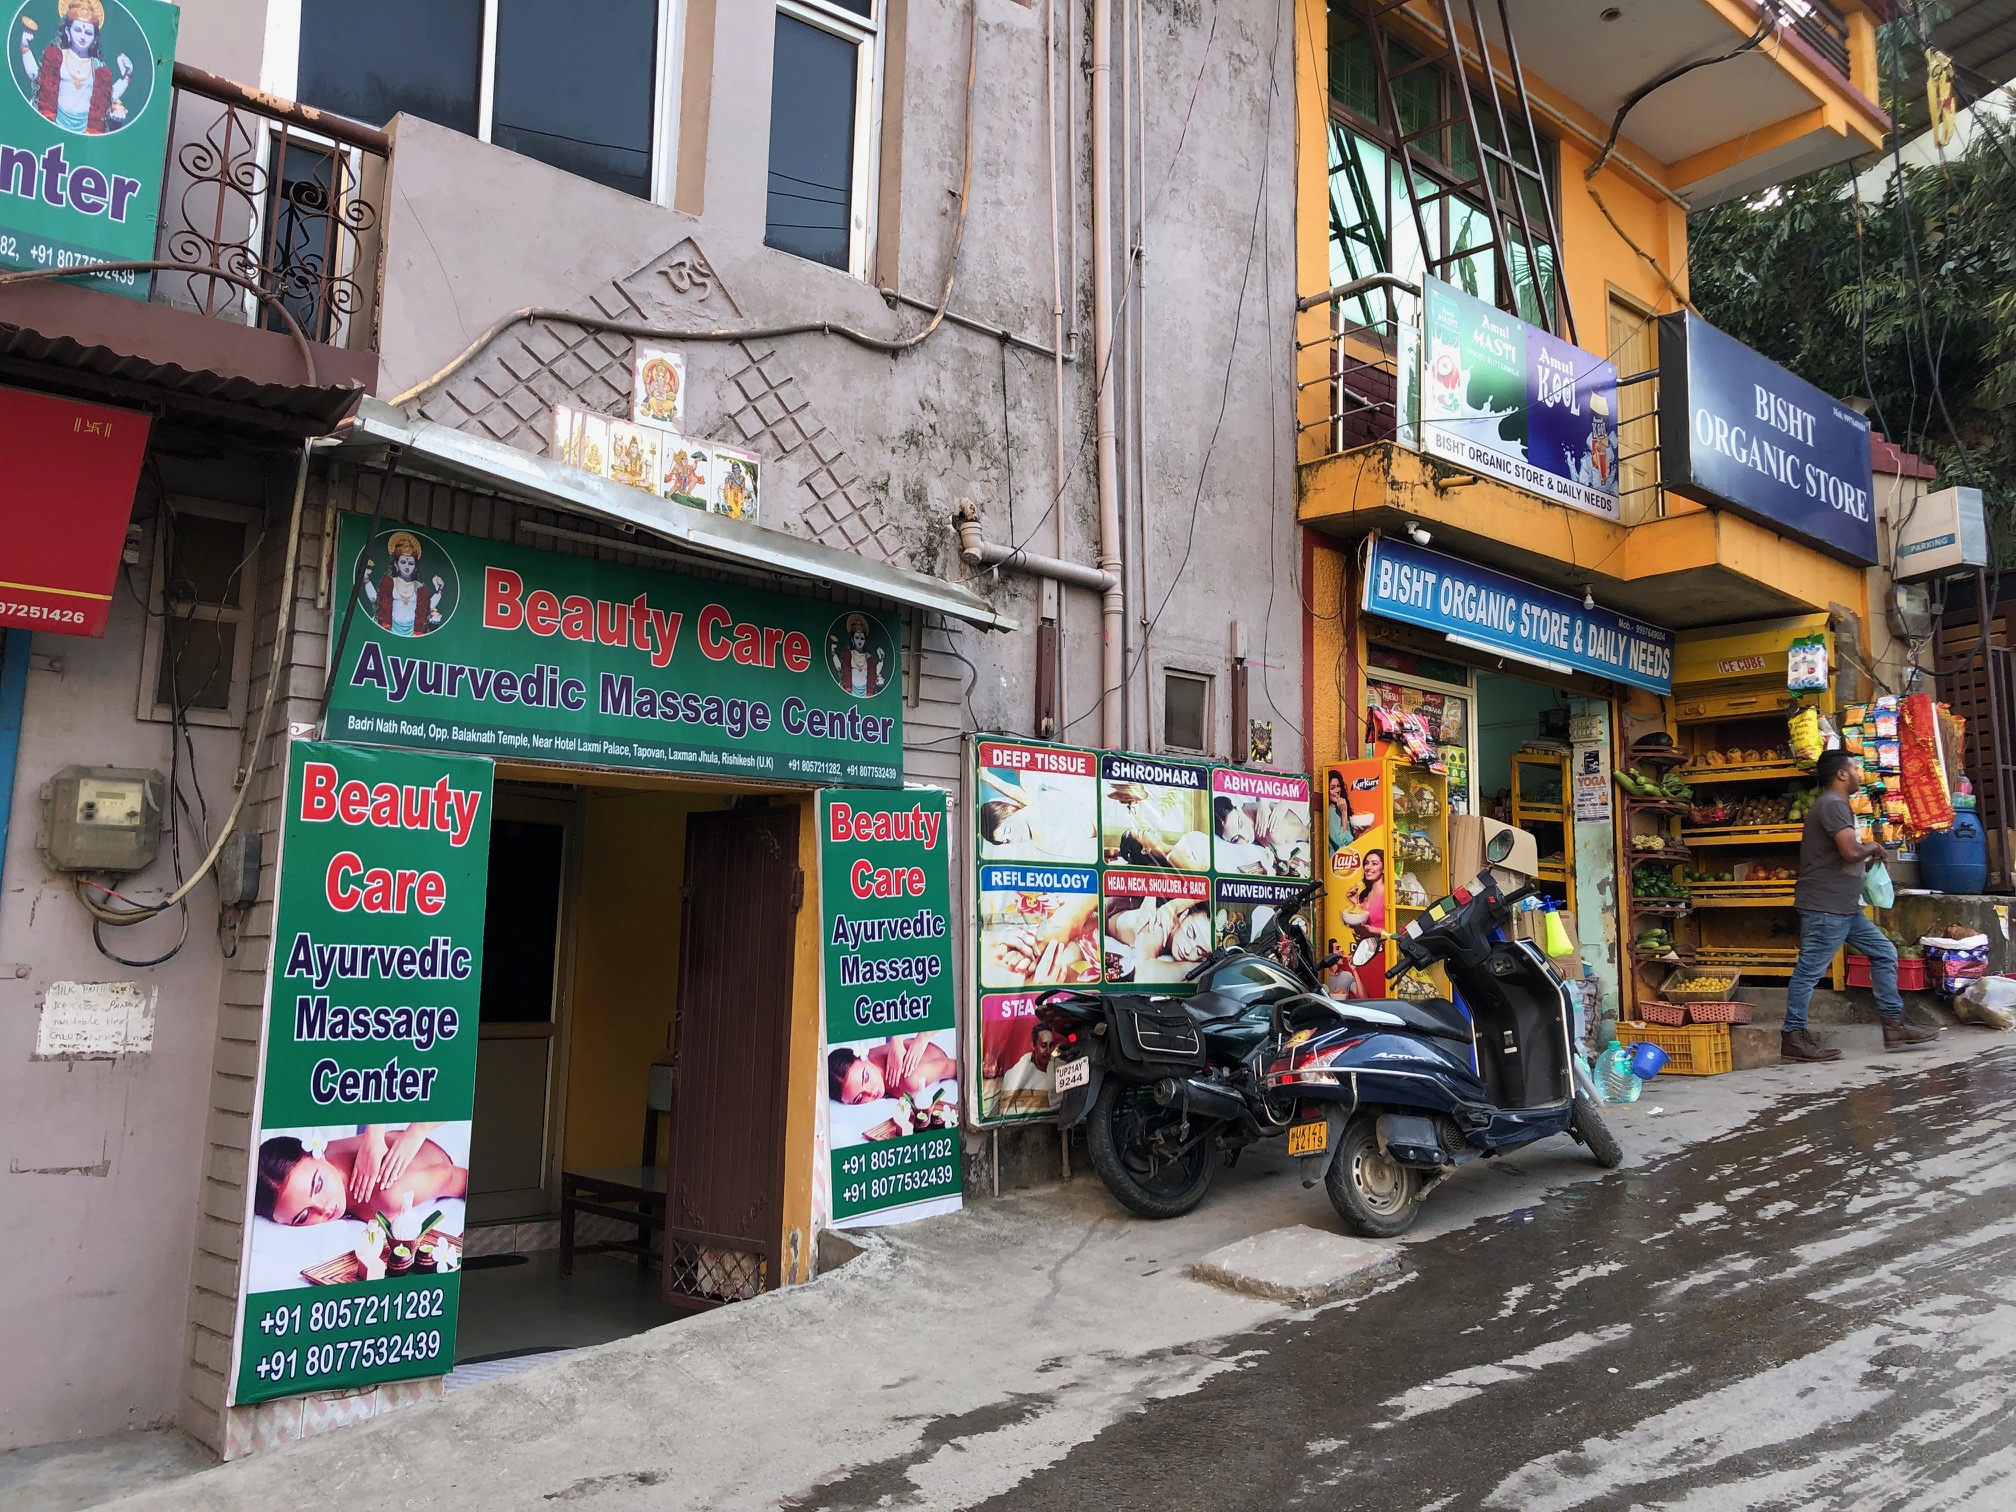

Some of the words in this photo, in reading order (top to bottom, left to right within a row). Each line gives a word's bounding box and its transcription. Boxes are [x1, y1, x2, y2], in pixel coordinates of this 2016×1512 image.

[30, 244, 53, 265] +91
[1472, 328, 1517, 363] MASTI
[1481, 314, 1510, 339] Amul
[1539, 347, 1574, 375] Amul
[1754, 383, 1816, 447] BISHT
[1436, 433, 1466, 457] BISHT
[1469, 447, 1512, 475] ORGANIC
[1514, 464, 1545, 487] STORE
[1547, 477, 1555, 491] &
[1556, 480, 1582, 504] DAILY
[1584, 488, 1612, 512] NEEDS
[1695, 408, 1801, 489] ORGANIC
[1805, 463, 1869, 523] STORE
[1910, 537, 1948, 552] PARKING
[483, 566, 683, 667] Beauty
[697, 604, 811, 672] Care
[1378, 559, 1437, 611] BISHT
[1440, 577, 1517, 634] ORGANIC
[1519, 602, 1571, 650] STORE
[1573, 618, 1583, 654] &
[1587, 623, 1631, 672] DAILY
[1629, 638, 1671, 680] NEEDS
[1718, 661, 1736, 674] ICE
[1737, 656, 1764, 671] CUBE
[350, 641, 586, 710] Ayurvedic
[599, 672, 771, 739] Massage
[782, 696, 894, 744] Center
[348, 715, 374, 731] Badri
[376, 718, 398, 734] Nath
[400, 721, 426, 739] Road,
[429, 724, 449, 742] Opp.
[452, 726, 496, 744] Balaknath
[498, 730, 530, 748] Temple,
[532, 734, 554, 748] Near
[555, 736, 576, 750] Hotel
[578, 738, 602, 753] Laxmi
[603, 741, 631, 758] Palace,
[633, 744, 667, 761] Tapovan,
[669, 747, 698, 762] Laxman
[698, 751, 720, 766] Jhula,
[722, 753, 756, 767] Rishikesh
[756, 756, 774, 771] (U.K)
[788, 761, 800, 771] +91
[847, 766, 859, 777] +91
[859, 767, 897, 779] 8077532439
[992, 749, 1031, 768] DEEP
[1034, 753, 1086, 774] TISSUE
[1111, 761, 1199, 786] SHIRODHARA
[1224, 775, 1299, 798] ABHYANGAM
[1577, 775, 1606, 788] YOGA
[300, 761, 482, 847] Beauty
[830, 802, 941, 849] Beauty
[325, 851, 446, 915] Care
[850, 859, 926, 899] Care
[991, 871, 1090, 889] REFLEXOLOGY
[1107, 876, 1126, 890] HEAD,
[1127, 877, 1149, 893] NECK,
[1149, 878, 1183, 893] SHOULDER
[1183, 881, 1189, 893] &
[1189, 881, 1206, 895] BACK
[1221, 882, 1273, 898] AYURVEDIC
[832, 909, 945, 951] Ayurvedic
[284, 933, 471, 989] Ayurvedic
[840, 955, 940, 987] Massage
[47, 984, 75, 996] MILK
[294, 995, 459, 1051] Massage
[854, 993, 932, 1027] Center
[310, 1057, 438, 1104] Center
[1060, 1072, 1083, 1088] 9244
[842, 1154, 867, 1177] +91
[870, 1138, 952, 1171] 8057211282
[843, 1181, 867, 1203] +91
[871, 1165, 953, 1196] 8077532439
[260, 1305, 302, 1336] +91
[309, 1288, 444, 1332] 8057211282
[256, 1349, 298, 1381] +91
[305, 1330, 441, 1377] 8077532439
